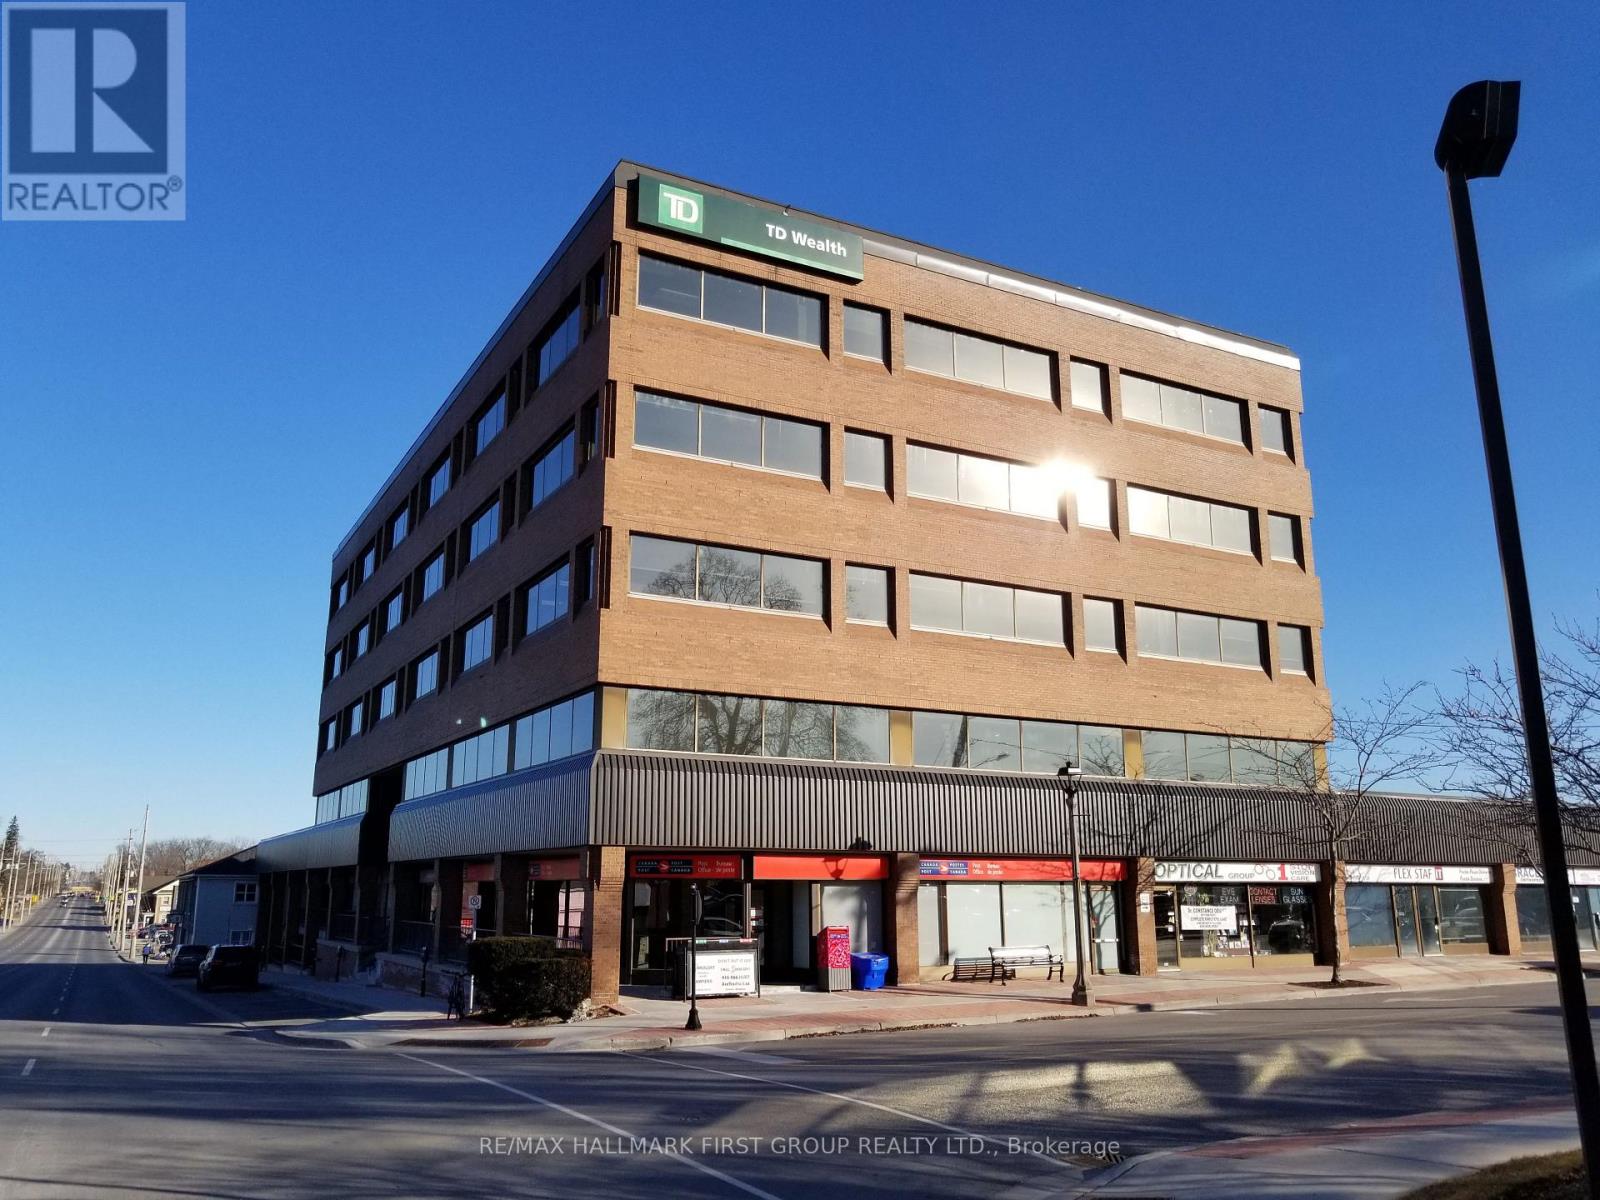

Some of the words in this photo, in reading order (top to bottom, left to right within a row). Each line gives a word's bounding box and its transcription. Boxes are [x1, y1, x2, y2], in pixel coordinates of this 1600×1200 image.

[663, 192, 699, 224] TD
[765, 223, 787, 240] TD
[791, 230, 847, 257] Wealth
[1155, 862, 1224, 879] OPTICAL
[1393, 867, 1412, 880] FLEX
[1414, 868, 1433, 880] STAF
[1290, 888, 1304, 896] SUN
[1219, 896, 1239, 904] EXAM
